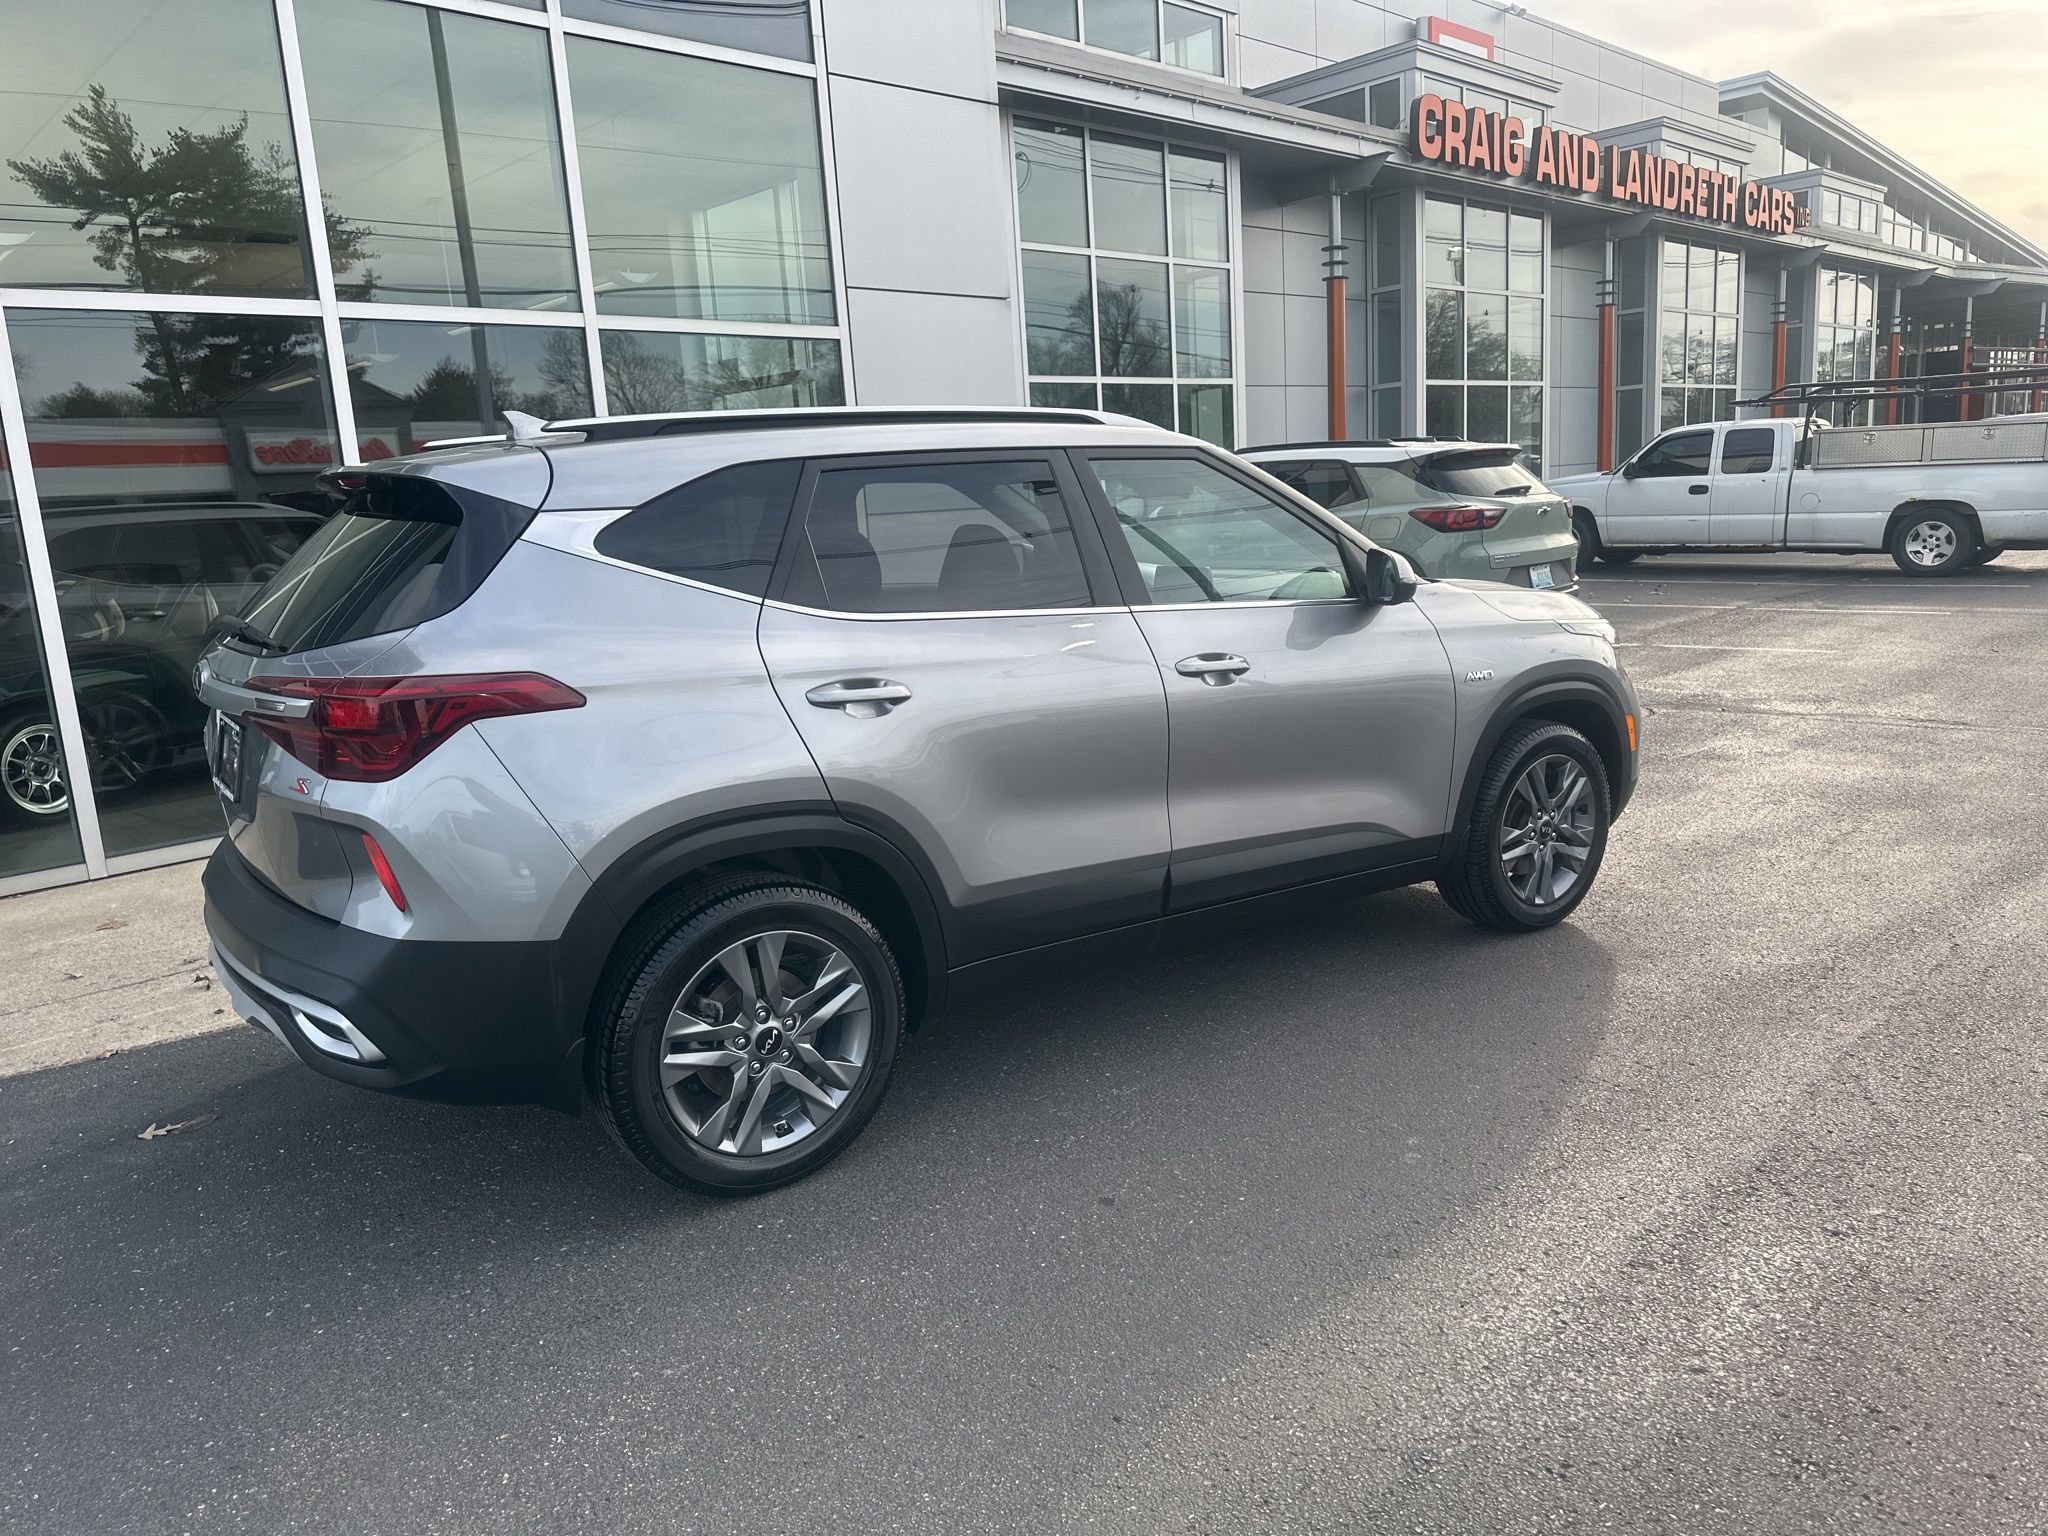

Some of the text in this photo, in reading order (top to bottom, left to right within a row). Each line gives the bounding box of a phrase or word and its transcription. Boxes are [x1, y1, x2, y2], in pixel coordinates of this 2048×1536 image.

[1418, 93, 1524, 177] CRAIG
[1536, 126, 1600, 193] AND
[1612, 144, 1737, 223] LANDRETH
[1744, 181, 1795, 235] CARS
[1464, 669, 1495, 682] AWD
